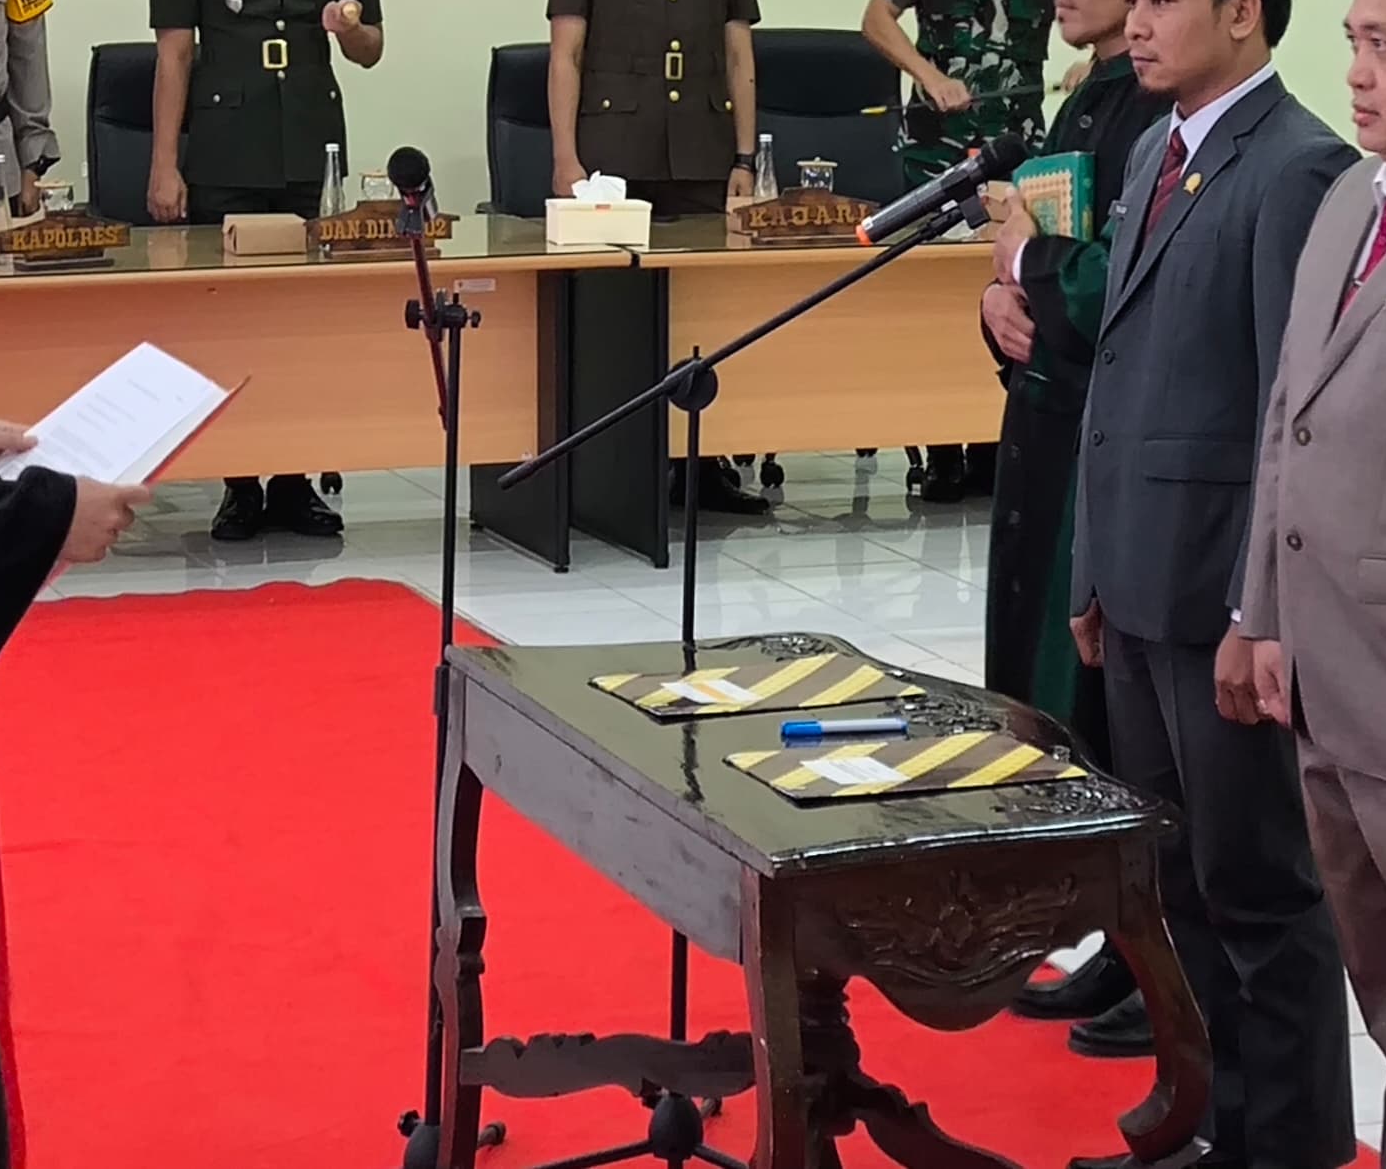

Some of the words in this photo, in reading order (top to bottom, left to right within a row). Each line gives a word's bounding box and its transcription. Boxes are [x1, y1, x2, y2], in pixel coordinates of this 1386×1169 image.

[749, 203, 869, 227] KAJARI
[13, 227, 123, 250] KAPOLRES
[320, 219, 362, 240] DAN
